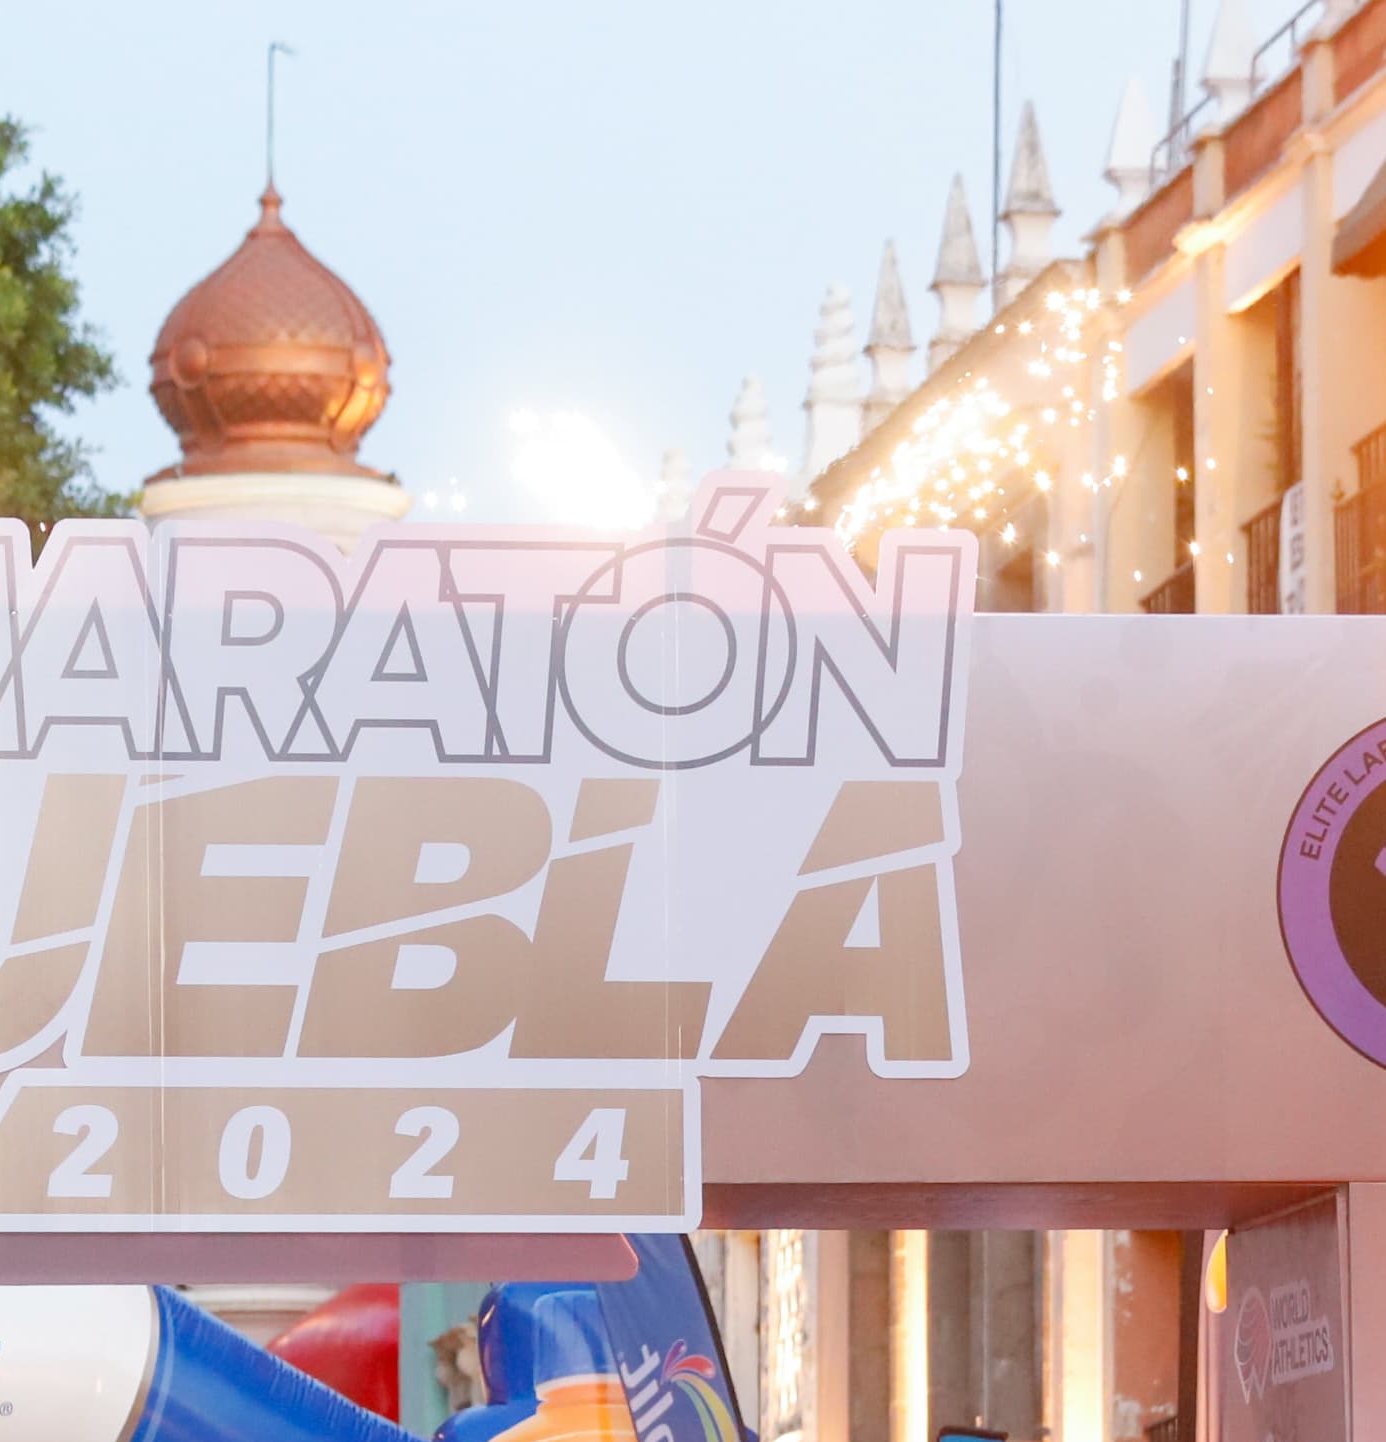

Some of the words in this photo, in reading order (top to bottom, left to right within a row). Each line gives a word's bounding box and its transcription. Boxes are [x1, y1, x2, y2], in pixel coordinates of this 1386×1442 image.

[1300, 782, 1351, 861] ELITE
[1272, 1289, 1310, 1329] WORLD
[1273, 1328, 1329, 1375] ATHLETICS
